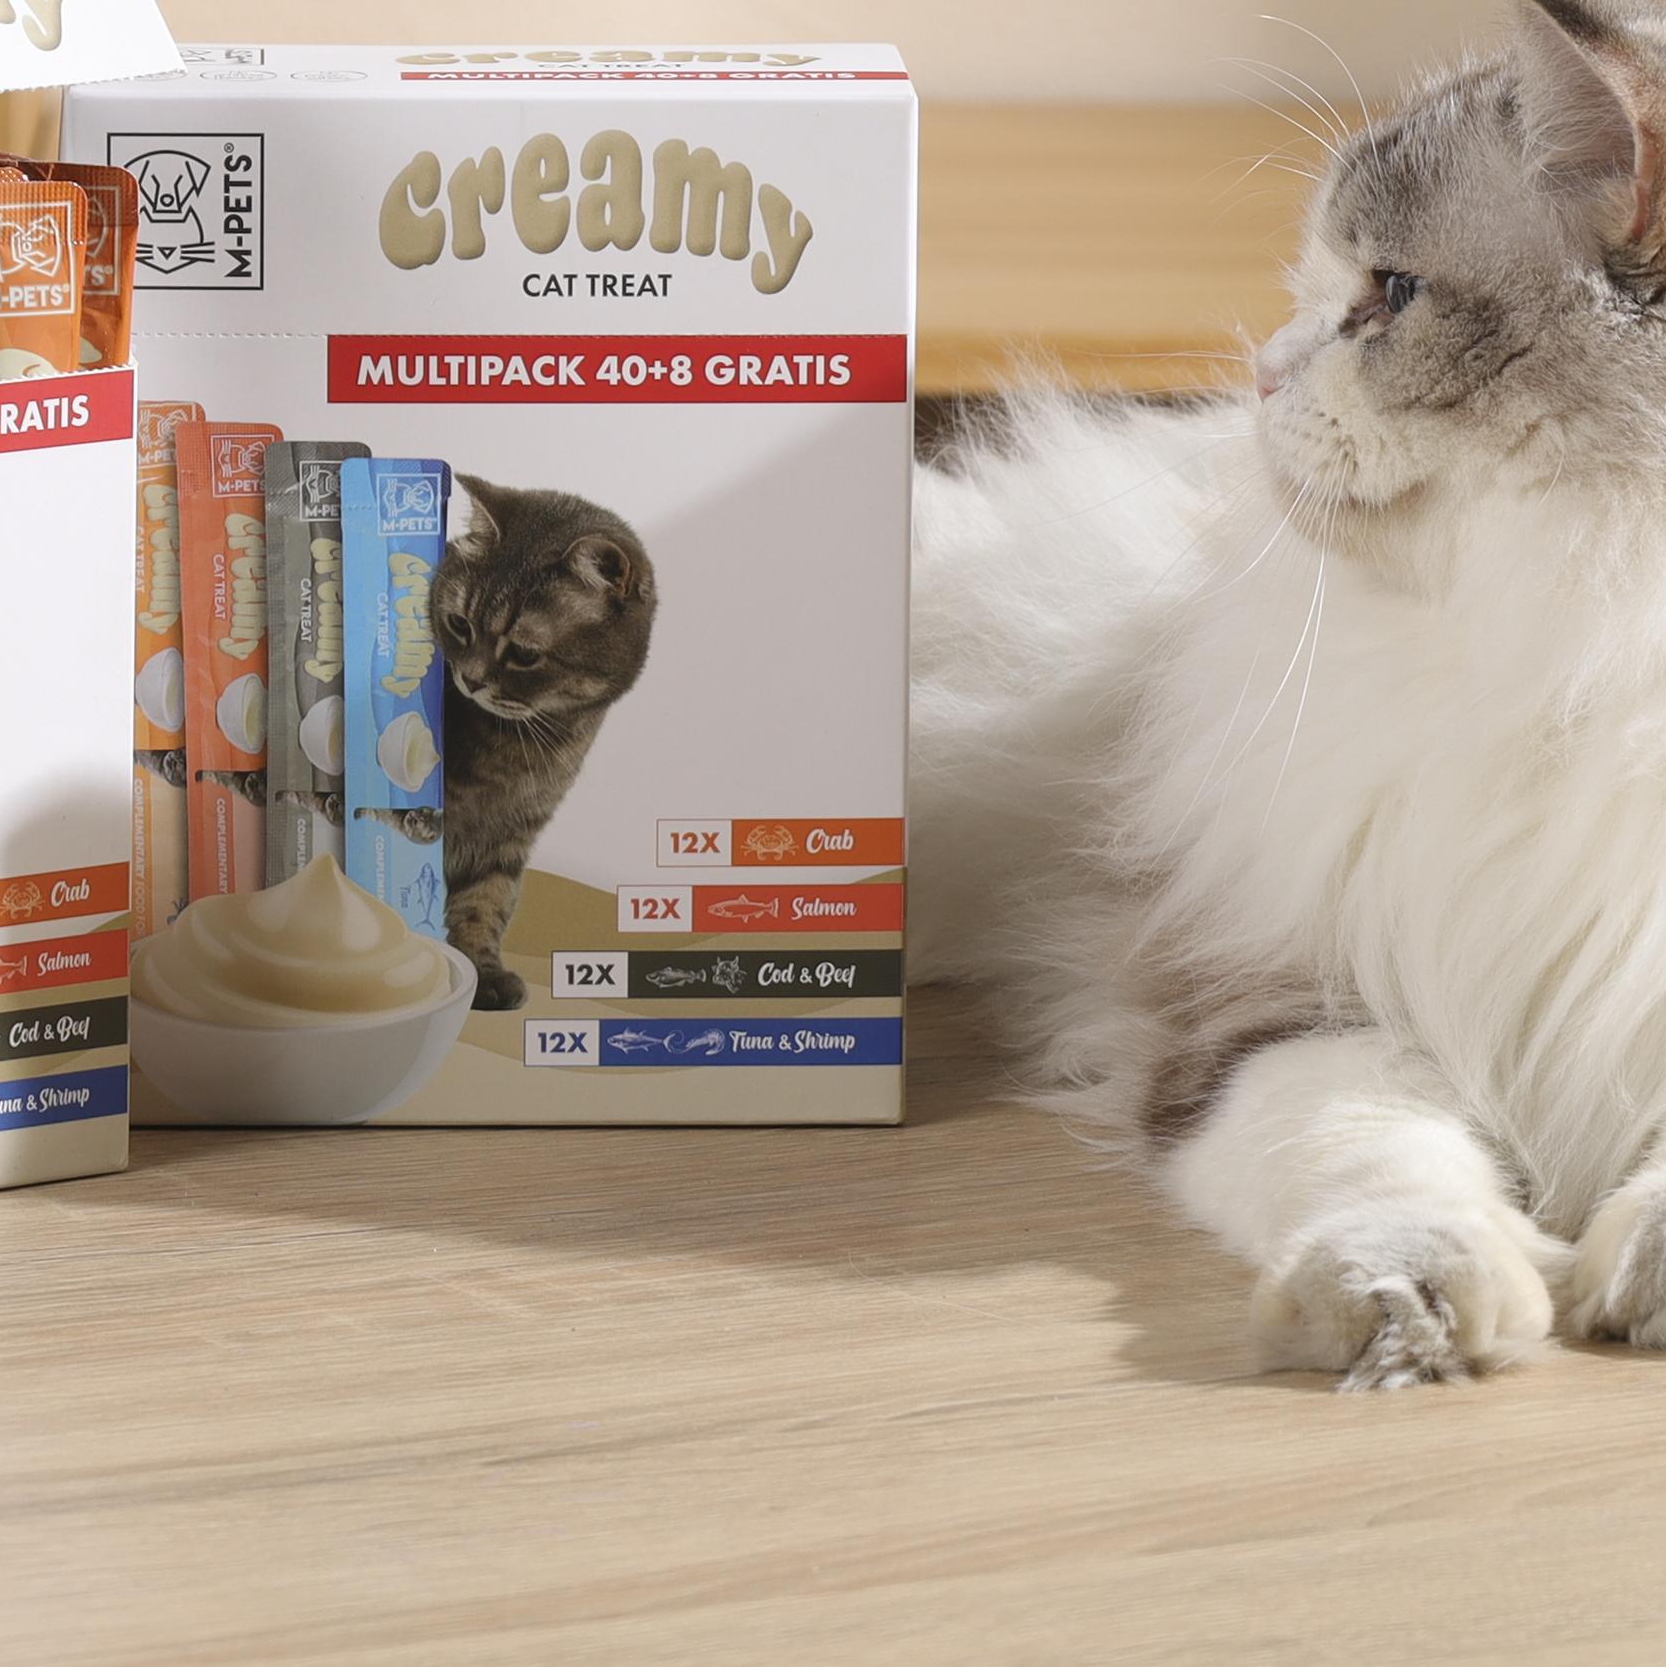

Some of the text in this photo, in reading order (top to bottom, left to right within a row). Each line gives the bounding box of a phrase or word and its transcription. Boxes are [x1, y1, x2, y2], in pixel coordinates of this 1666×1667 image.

[395, 50, 822, 68] creamy
[428, 72, 626, 80] MULTIPACK
[729, 72, 857, 80] GRATIS
[378, 128, 814, 295] creamy
[521, 272, 673, 299] CAT TREAT
[355, 353, 852, 387] MULTIPACK 40+8 GRATIS
[213, 554, 226, 620] CAT TREAT
[300, 577, 312, 644] CAT TREAT
[376, 592, 389, 658] CAT TREAT
[670, 828, 854, 855] 12X Crab
[50, 877, 90, 908] Crab
[630, 896, 858, 921] 12X Salmon
[37, 949, 92, 977] Salmon
[565, 961, 858, 988] 12X Cod & Beef
[8, 1019, 40, 1049] Cod
[43, 1024, 55, 1040] &
[56, 1014, 91, 1043] Beef
[537, 1029, 856, 1055] 12X Tuna & Shrimp
[26, 1093, 38, 1111] &
[38, 1087, 91, 1114] Shrimp
